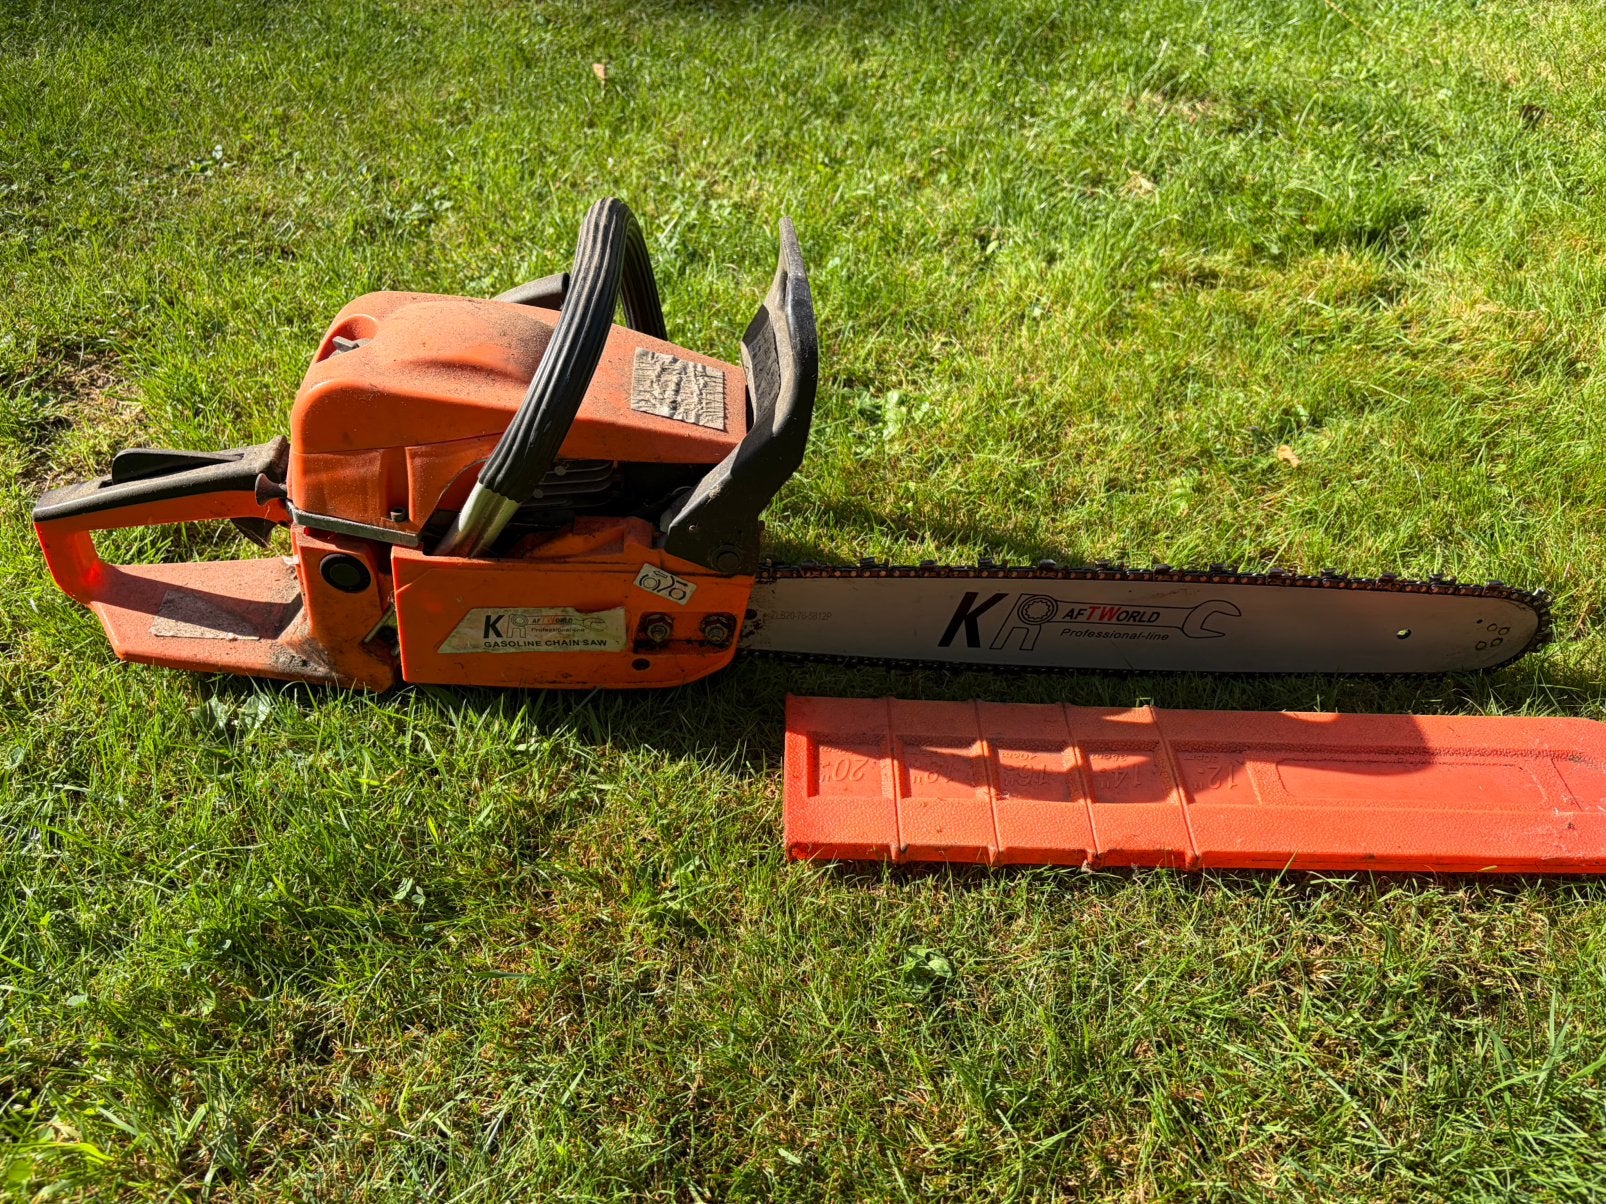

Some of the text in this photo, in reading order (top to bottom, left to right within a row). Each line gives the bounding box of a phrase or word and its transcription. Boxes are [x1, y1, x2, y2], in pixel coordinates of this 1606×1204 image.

[1060, 628, 1170, 642] Professional-line
[484, 639, 607, 648] GASOLINE CHAIN SAW
